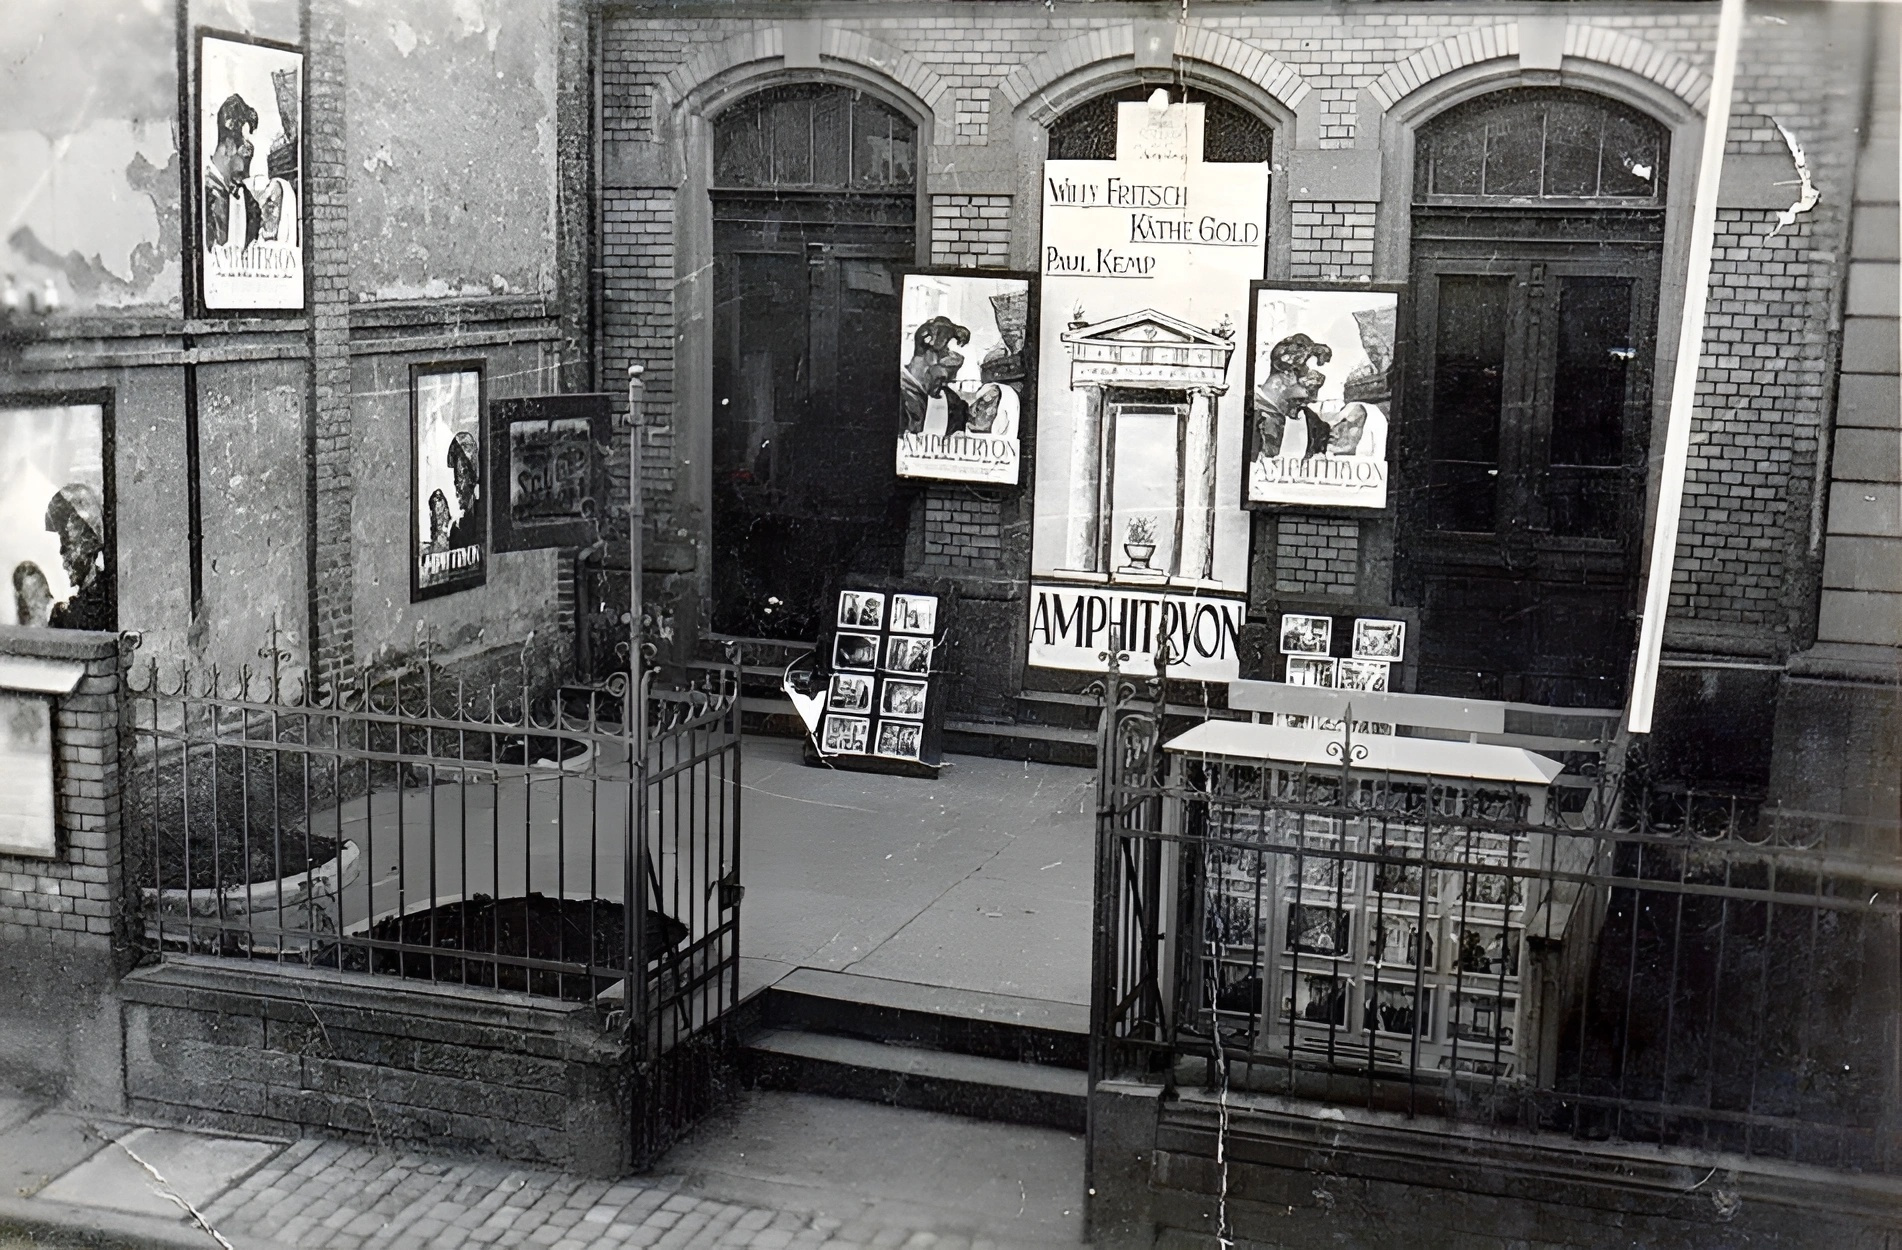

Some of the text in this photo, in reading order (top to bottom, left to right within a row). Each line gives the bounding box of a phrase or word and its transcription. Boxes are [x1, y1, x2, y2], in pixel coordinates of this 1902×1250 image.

[1048, 177, 1188, 207] WILLY FRITSCH
[1199, 215, 1259, 243] GOLD
[1046, 246, 1156, 274] PAUL KEMP
[1029, 592, 1243, 667] AMPHITRYON
